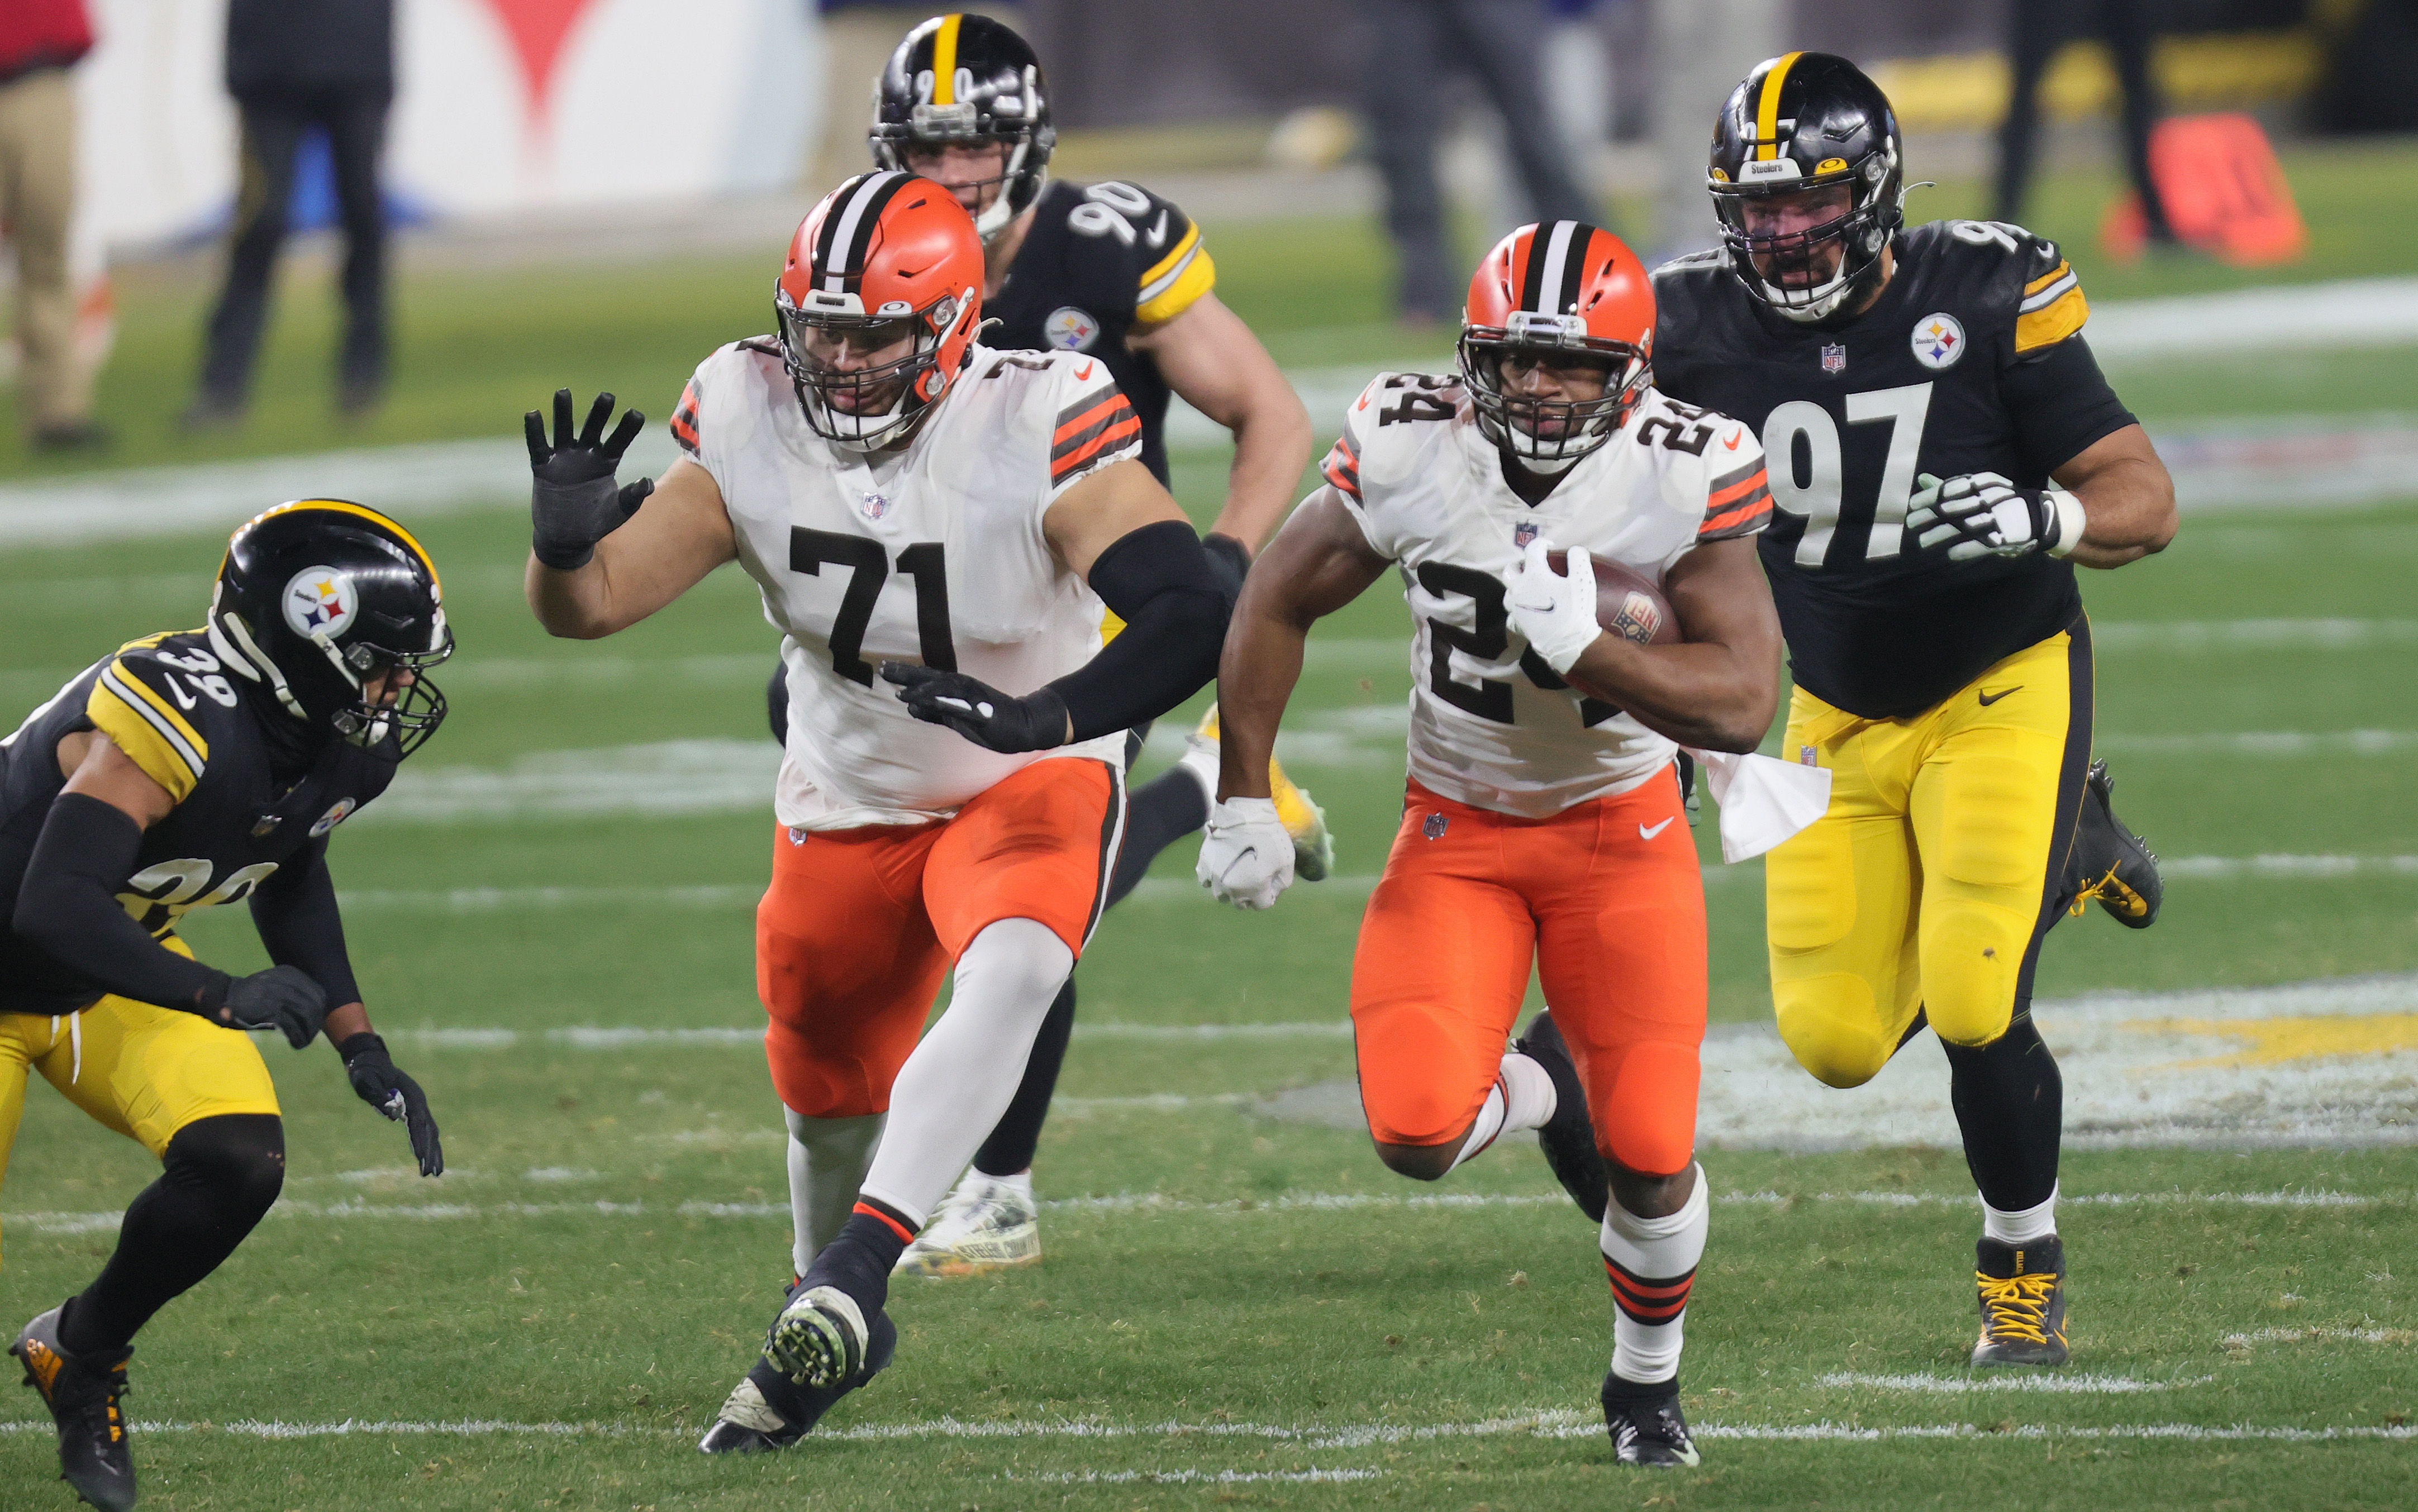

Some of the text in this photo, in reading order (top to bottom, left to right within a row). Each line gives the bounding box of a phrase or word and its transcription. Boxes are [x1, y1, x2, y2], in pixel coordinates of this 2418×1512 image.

[916, 67, 973, 104] 90
[1743, 118, 1797, 161] 97
[1751, 163, 1783, 174] Steelers
[1068, 181, 1151, 245] 90
[1825, 356, 1843, 368] NFL
[1762, 380, 1934, 567] 97
[789, 525, 958, 689] 71
[1629, 599, 1657, 631] NFL
[156, 647, 238, 708] 39
